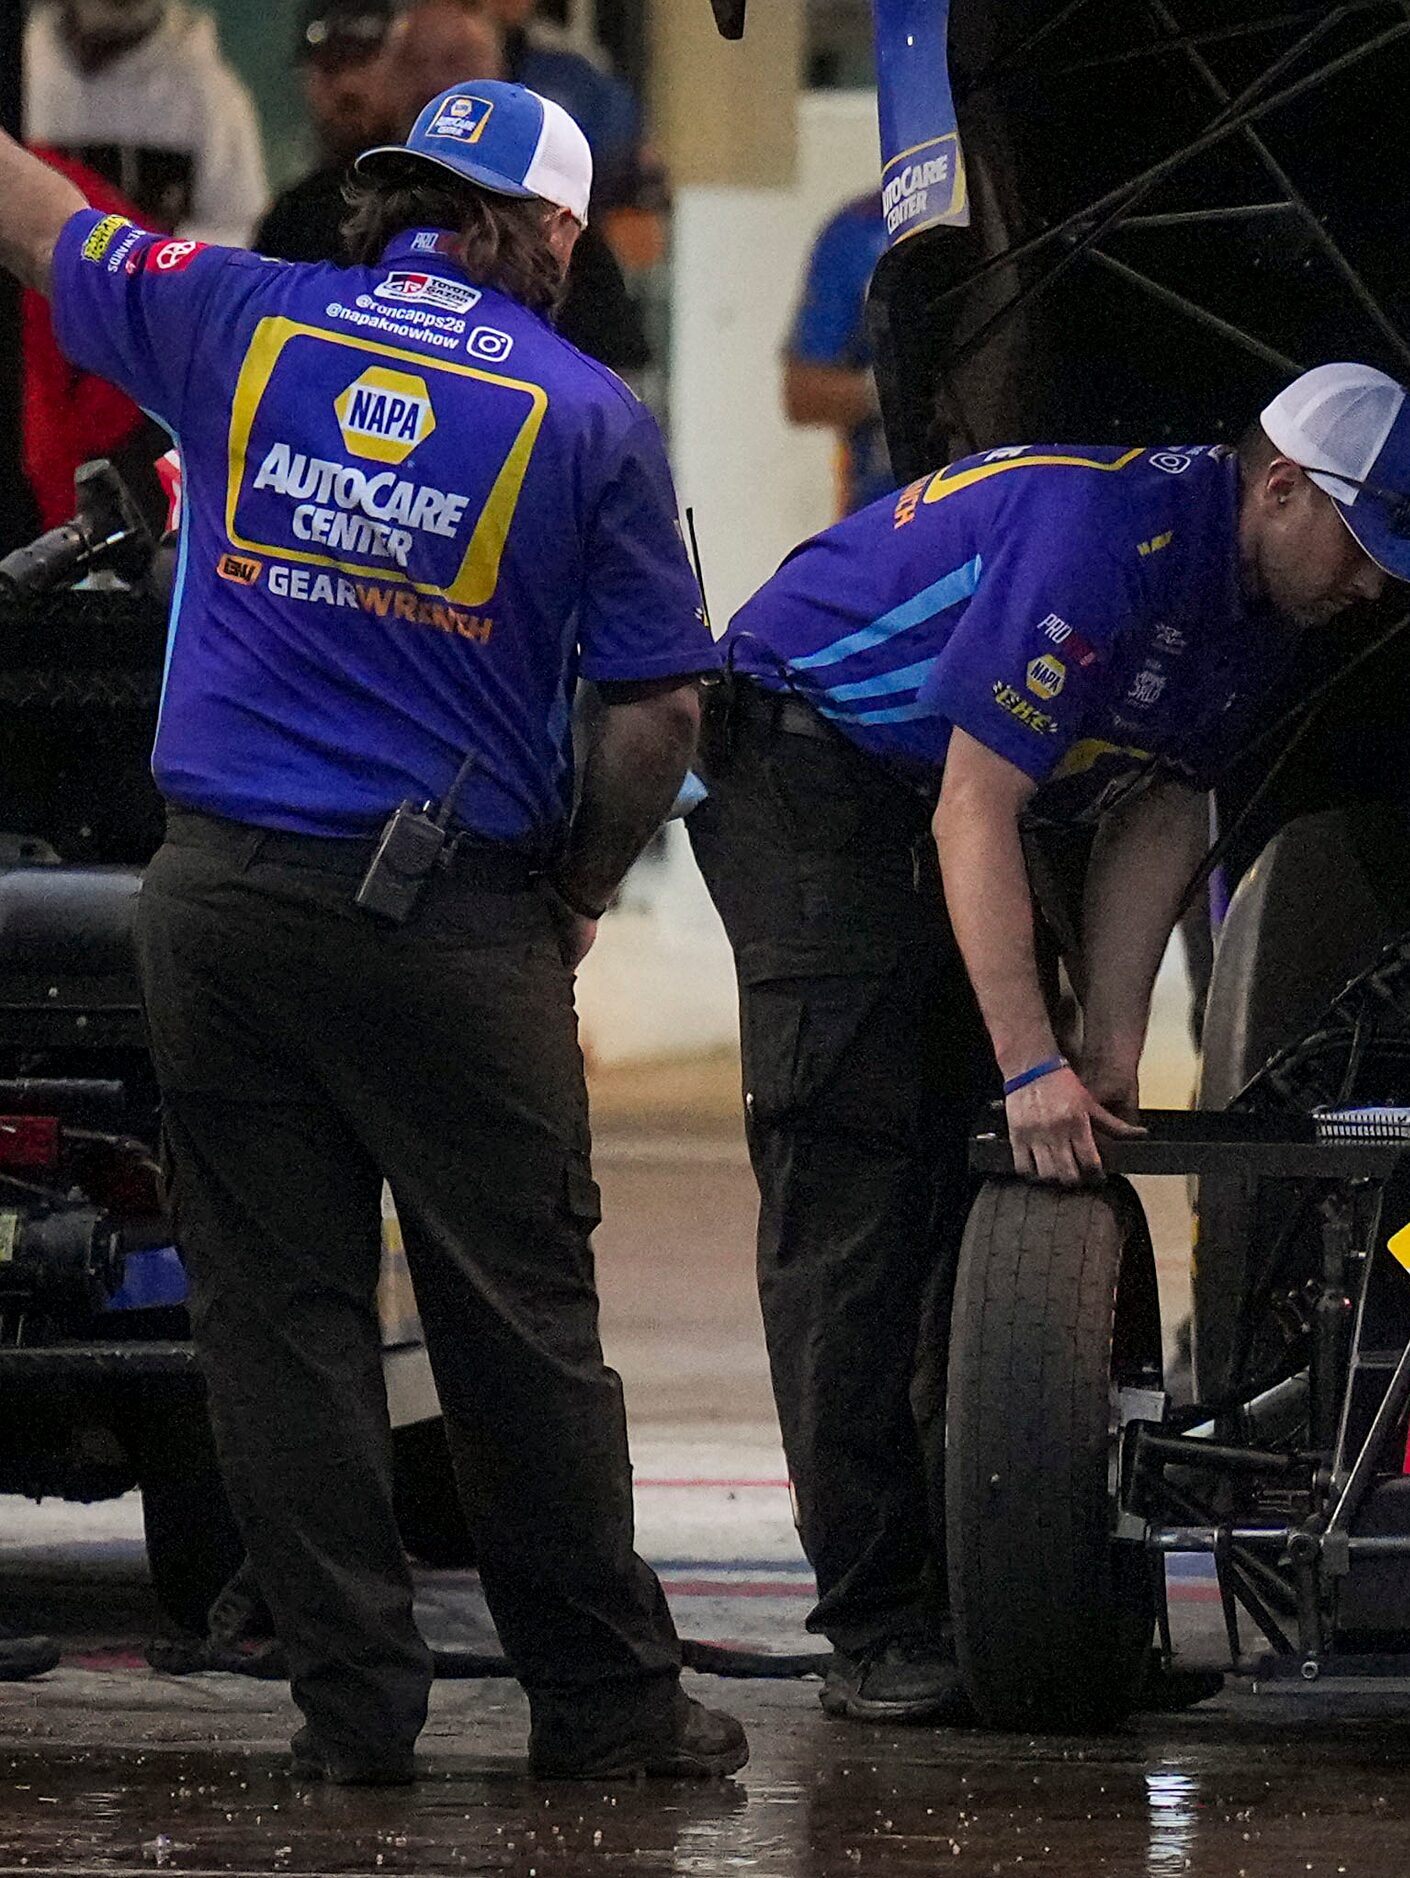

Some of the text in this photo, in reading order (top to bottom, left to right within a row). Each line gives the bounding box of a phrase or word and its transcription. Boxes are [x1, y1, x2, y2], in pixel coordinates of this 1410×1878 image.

[325, 302, 460, 349] @napaknowhow
[355, 294, 466, 334] @roncapps28
[348, 390, 420, 441] NAPA
[252, 442, 471, 539] AUTOCARE
[292, 504, 414, 566] CENTER
[1037, 613, 1073, 644] PRO
[1031, 661, 1061, 692] NAPA
